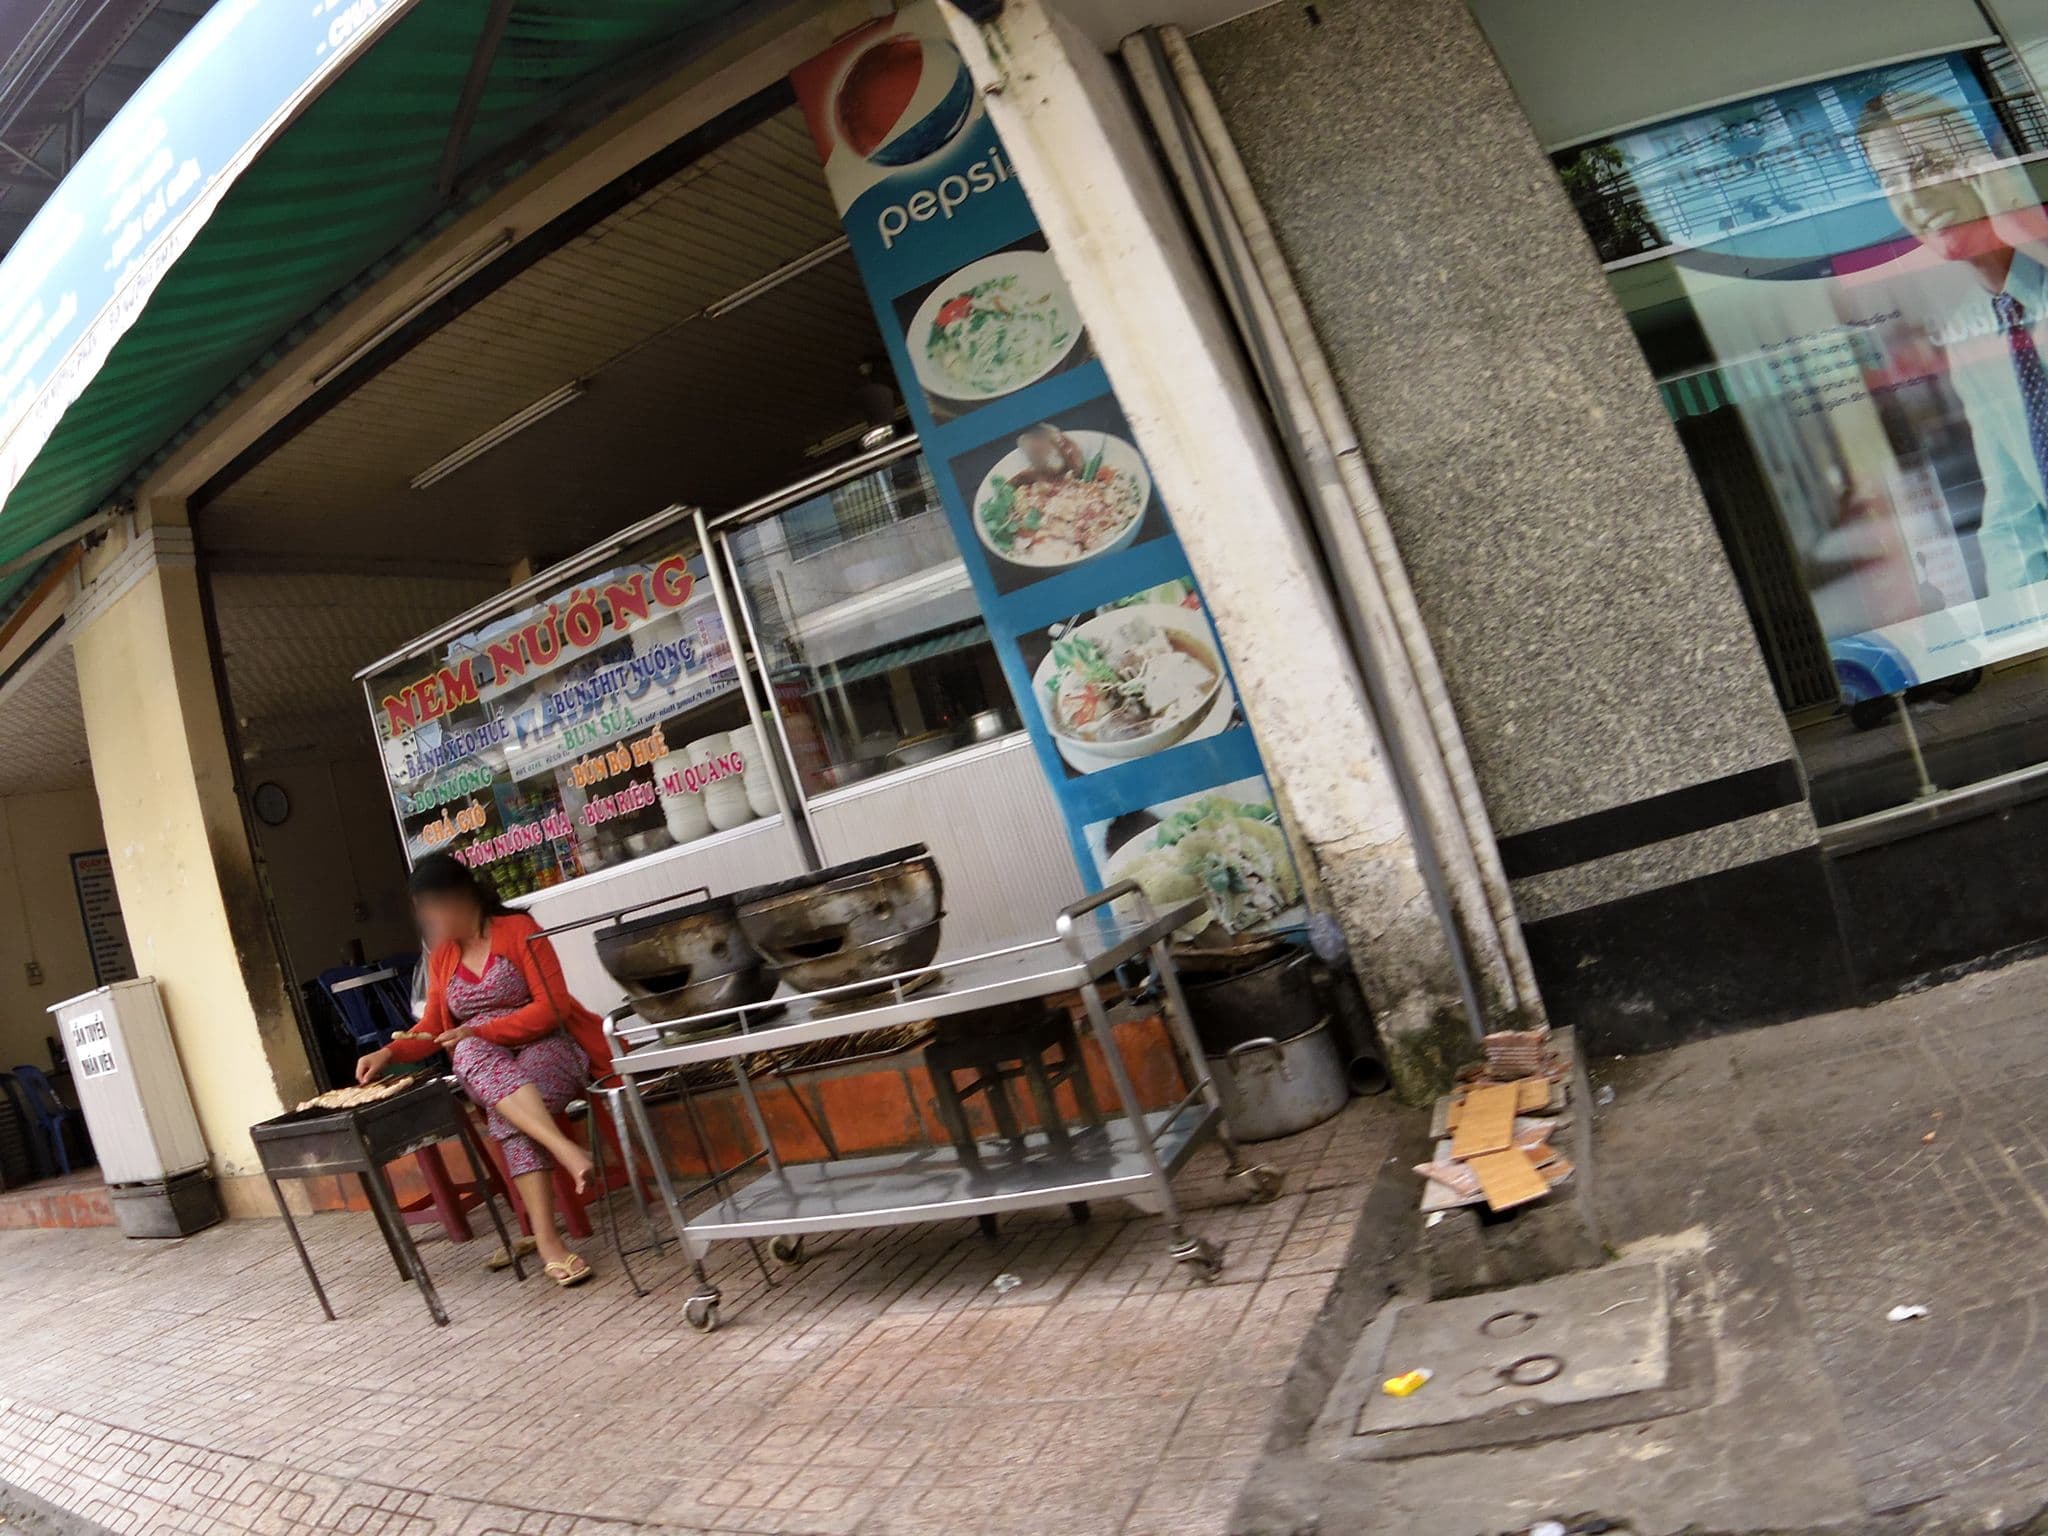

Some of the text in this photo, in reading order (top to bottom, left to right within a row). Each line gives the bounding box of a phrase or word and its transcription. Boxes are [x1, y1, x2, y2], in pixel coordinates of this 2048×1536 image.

[877, 147, 989, 250] pepsi
[382, 657, 480, 737] NEM
[487, 555, 696, 687] NƯỚNG
[554, 681, 590, 714] BÚN
[628, 638, 693, 682] NƯỚNG
[476, 705, 511, 749] HUẾ
[571, 753, 609, 788] BÚN
[606, 741, 632, 776] BÒ
[630, 722, 669, 767] HUẾ
[422, 799, 486, 846] CHẢ GIÒ
[583, 751, 745, 827] BÚN RIÊU MÌ QUẢNG
[465, 837, 496, 868] TÔM
[493, 821, 543, 859] NƯỚNG
[541, 807, 573, 841] MÍA
